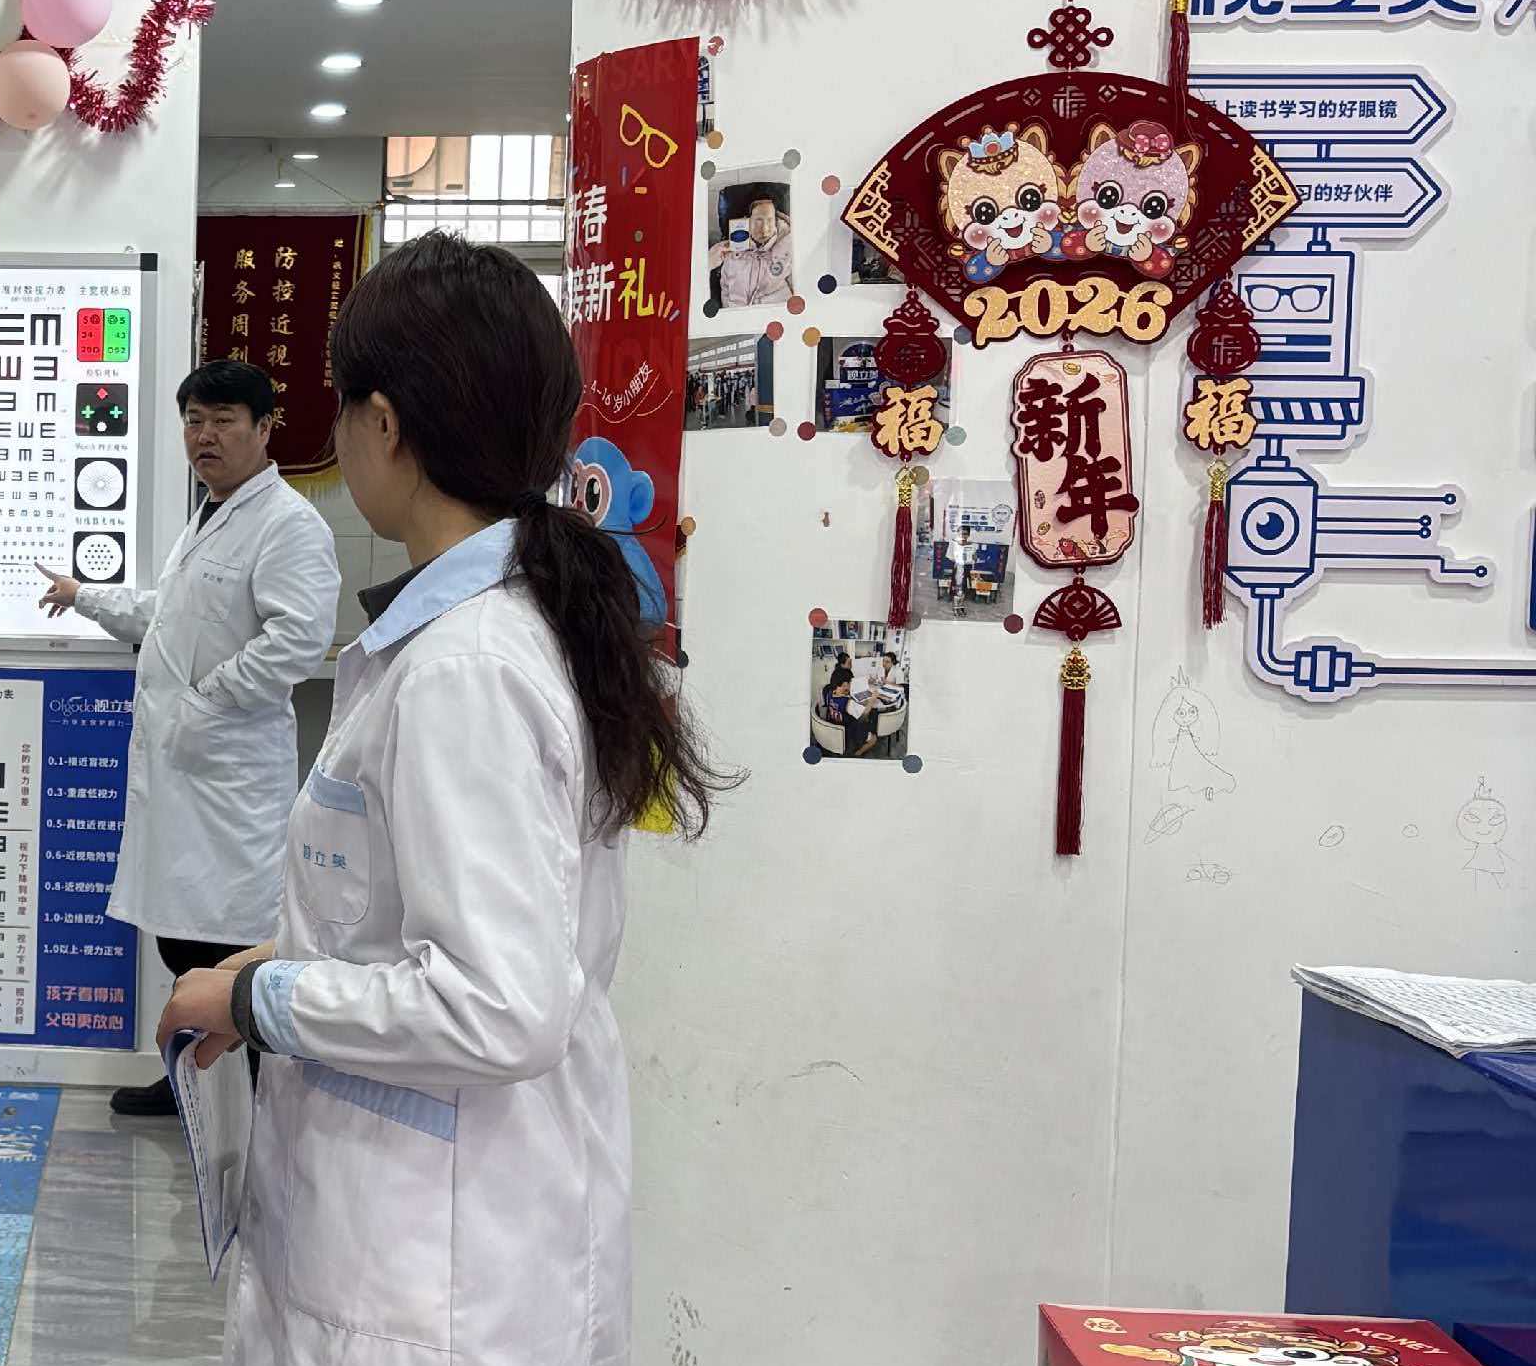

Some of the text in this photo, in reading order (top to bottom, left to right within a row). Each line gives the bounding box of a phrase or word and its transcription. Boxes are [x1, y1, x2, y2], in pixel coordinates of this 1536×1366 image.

[1202, 99, 1397, 119] 上读书学习的好眼镜
[965, 276, 1172, 348] 2026
[875, 385, 943, 454] 福
[1186, 377, 1258, 450] 福
[1016, 372, 1140, 540] 新年
[47, 787, 117, 800] 0.3-重度低视力
[45, 850, 120, 863] 0.6-近视危险警
[43, 943, 124, 957] 1.0以上-视力正常
[46, 985, 125, 1004] 孩子看得清
[45, 1012, 124, 1030] 父母更放心
[1344, 1327, 1450, 1356] MONEY
